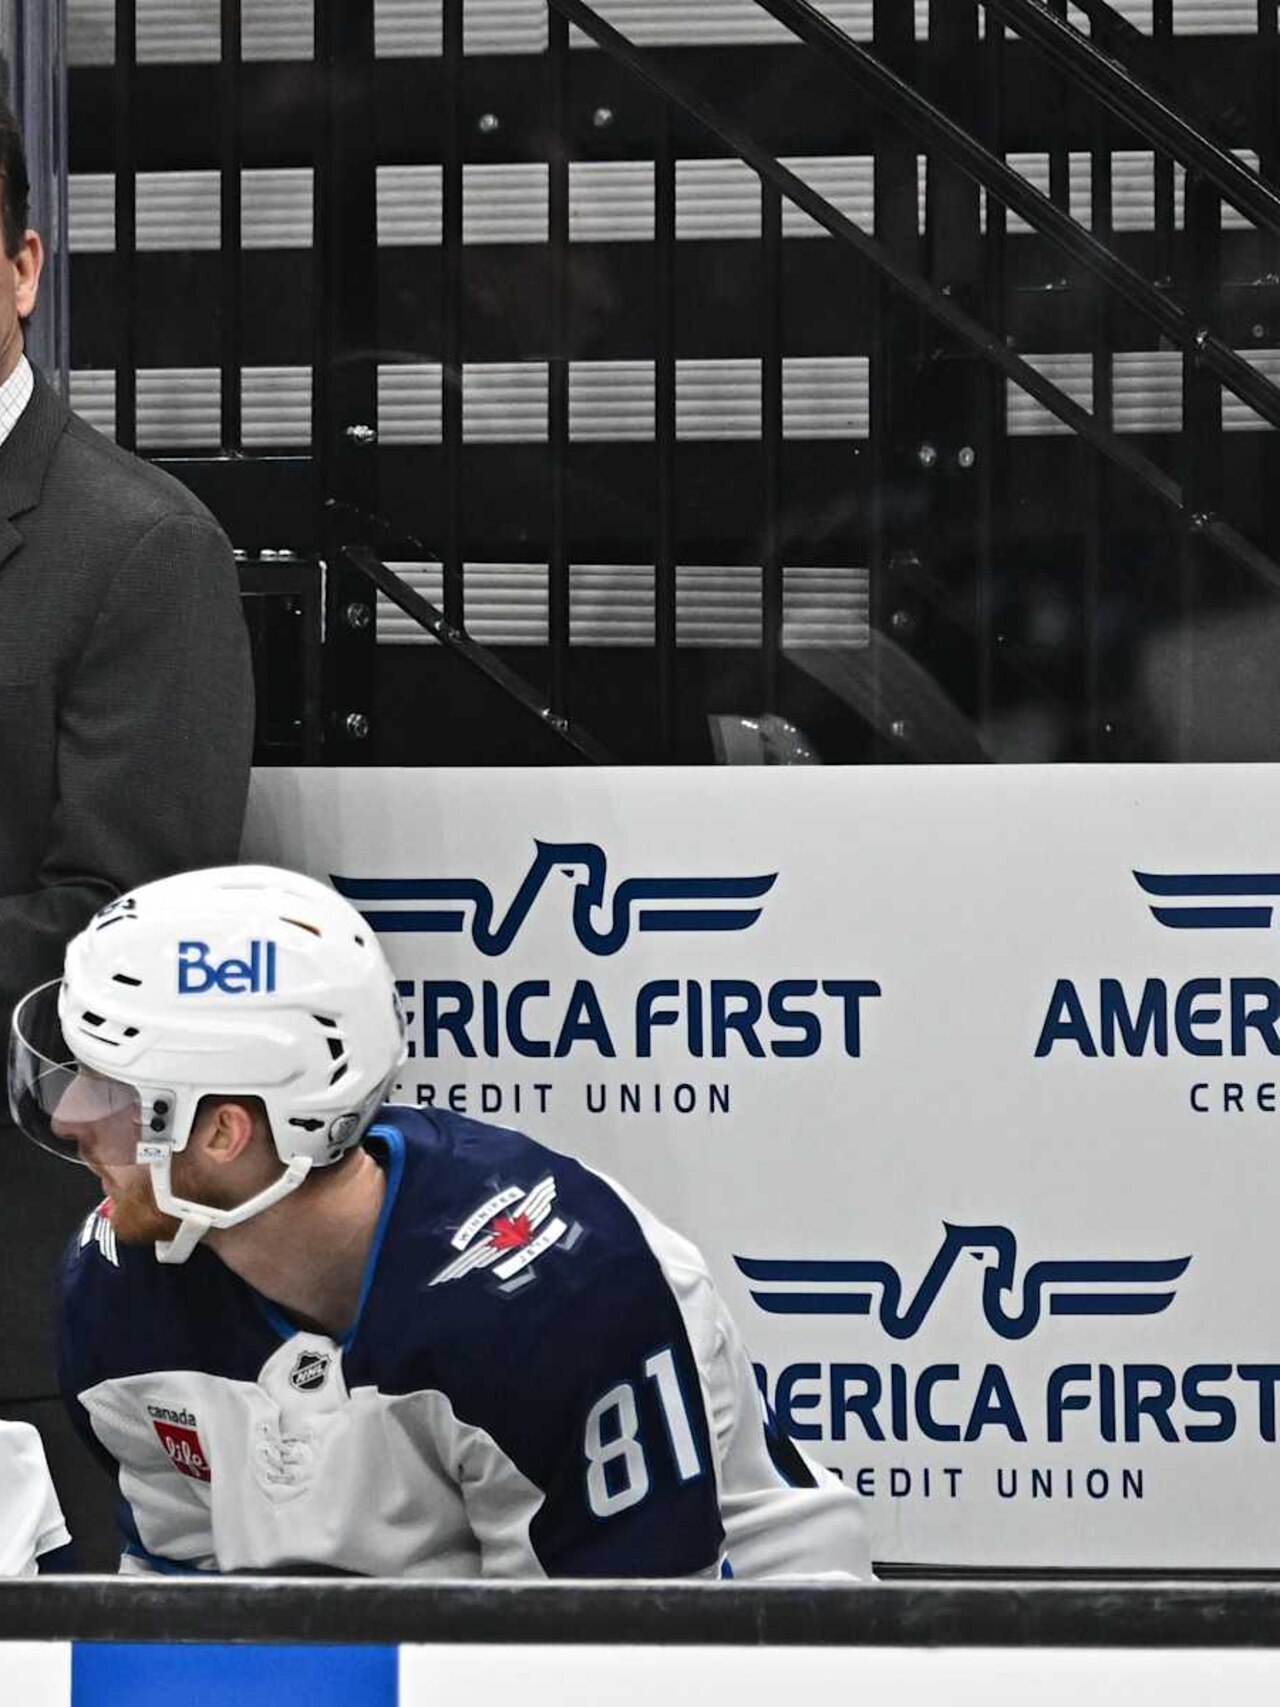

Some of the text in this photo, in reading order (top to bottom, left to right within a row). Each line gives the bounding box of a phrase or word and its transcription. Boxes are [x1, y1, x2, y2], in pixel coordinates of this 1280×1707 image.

[178, 940, 276, 994] Bell
[636, 979, 881, 1058] FIRST
[1034, 978, 1280, 1057] AMER
[386, 1083, 730, 1113] REDIT UNION
[1190, 1083, 1276, 1112] CRE
[147, 1405, 196, 1426] canada
[752, 1363, 1280, 1442] ERICA FIRST
[584, 1347, 702, 1517] 81
[827, 1467, 1143, 1499] EDIT UNION
